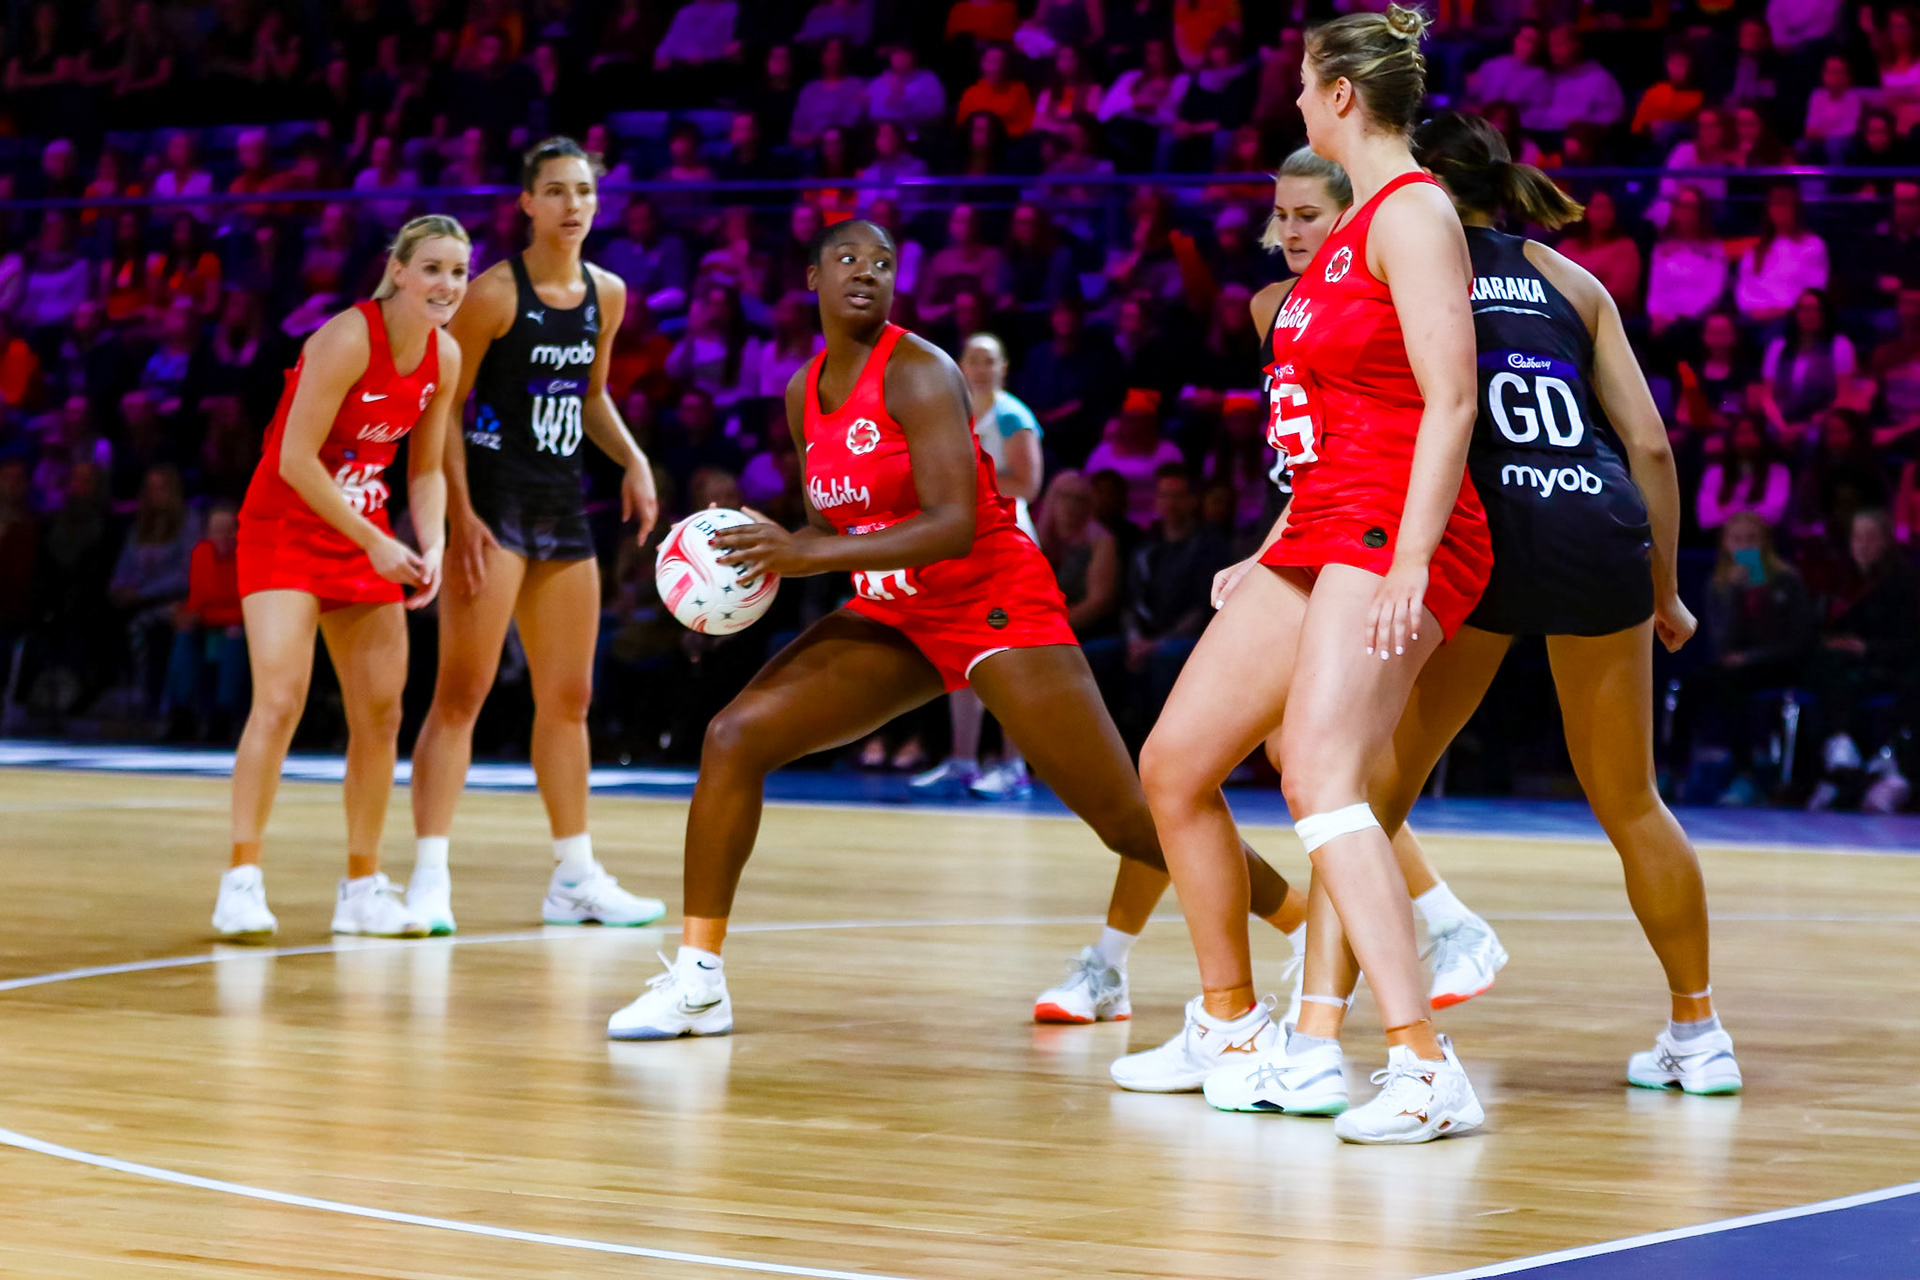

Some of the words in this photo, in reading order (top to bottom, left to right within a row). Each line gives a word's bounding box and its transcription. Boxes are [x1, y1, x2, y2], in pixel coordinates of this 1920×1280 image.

[530, 339, 596, 371] myob
[1508, 353, 1551, 370] Cadbury
[1488, 372, 1584, 447] GD
[1501, 464, 1603, 498] myob
